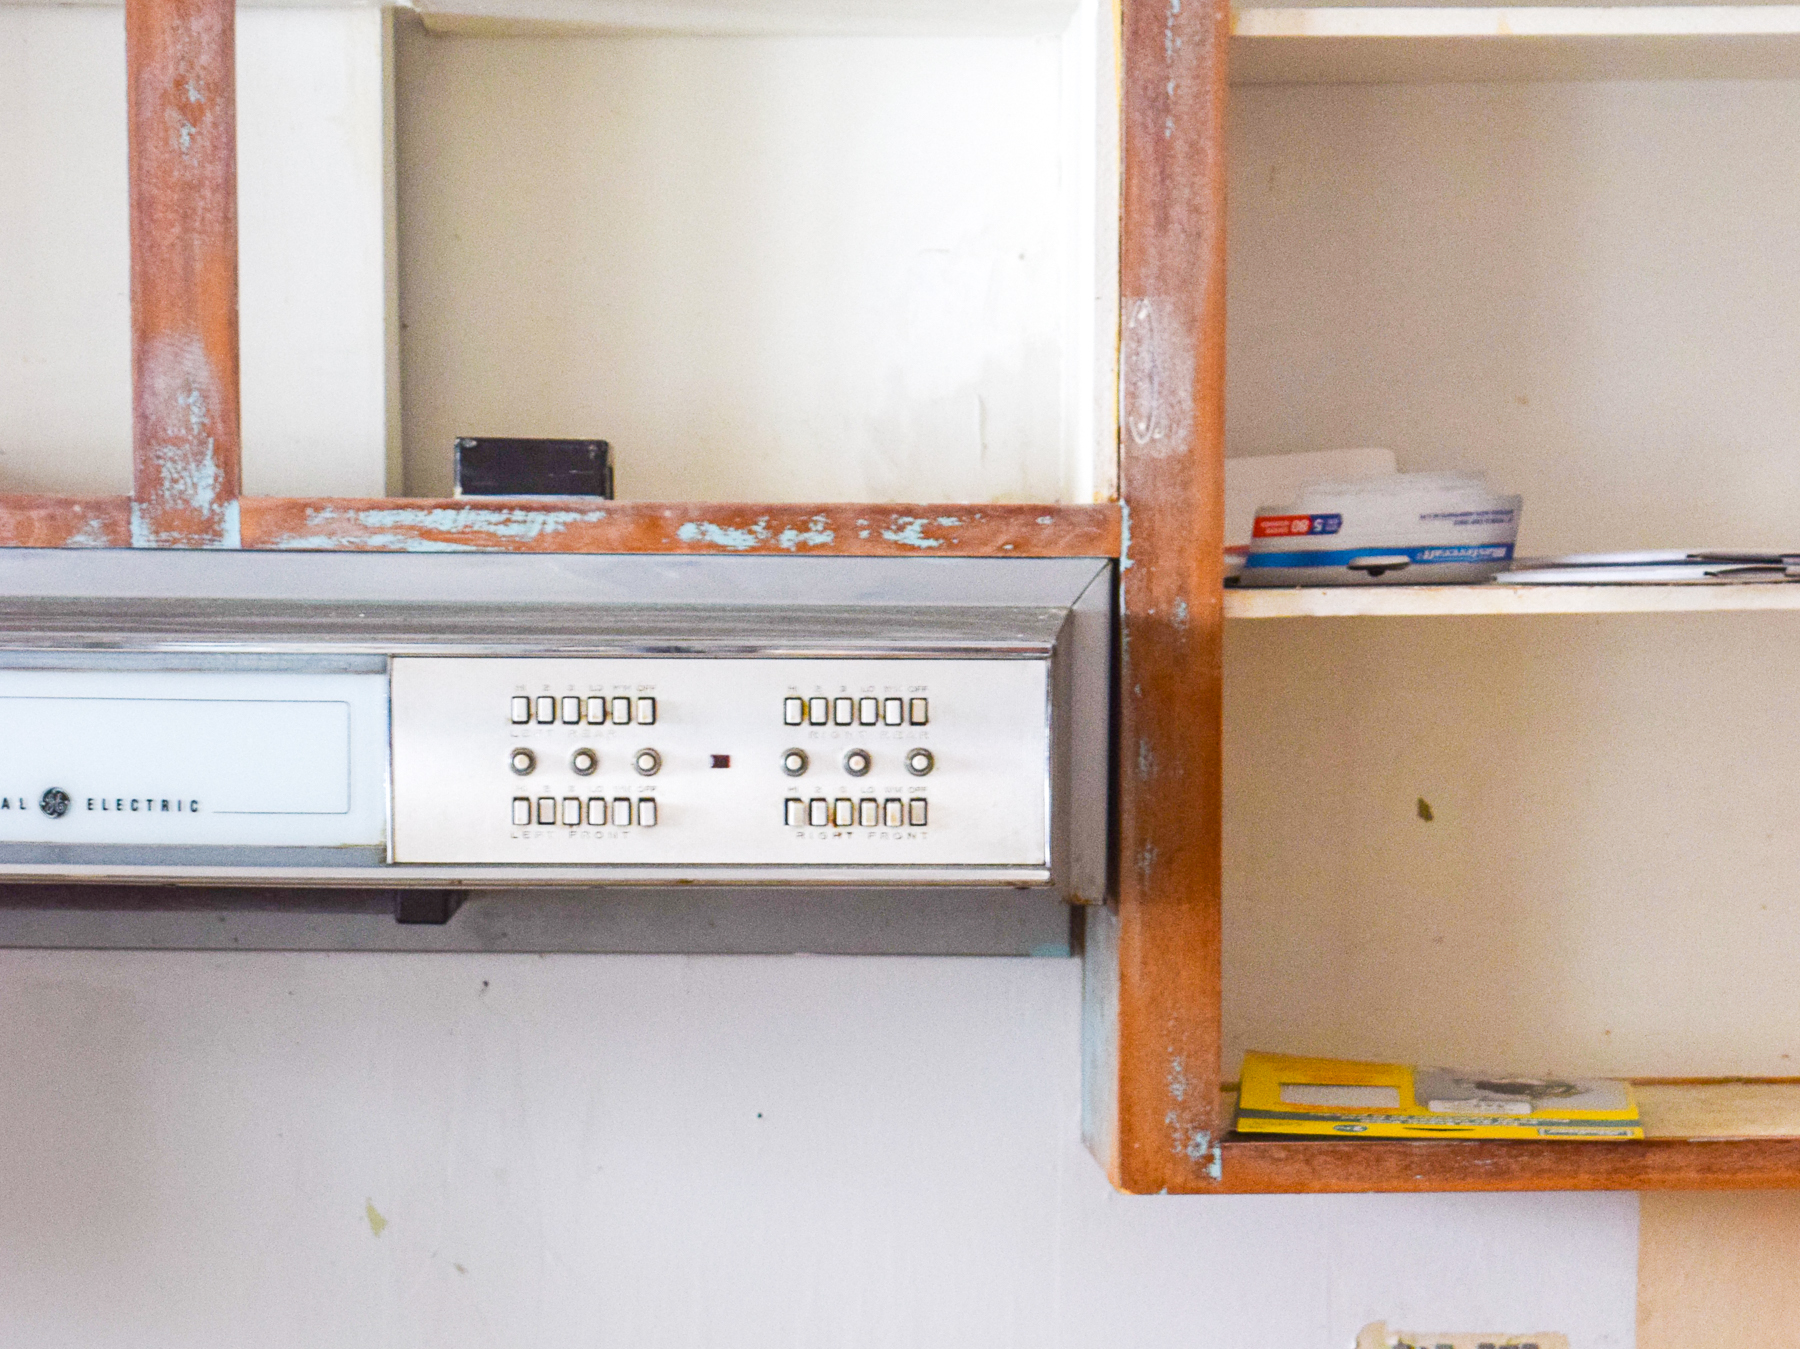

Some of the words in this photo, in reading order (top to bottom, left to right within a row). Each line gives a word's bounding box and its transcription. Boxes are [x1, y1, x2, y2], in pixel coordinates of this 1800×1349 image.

[86, 798, 200, 812] ELECTRIC
[510, 831, 554, 839] LEFT
[568, 831, 631, 839] FRONT
[796, 831, 854, 840] RIGHT
[868, 831, 928, 840] FRONT
